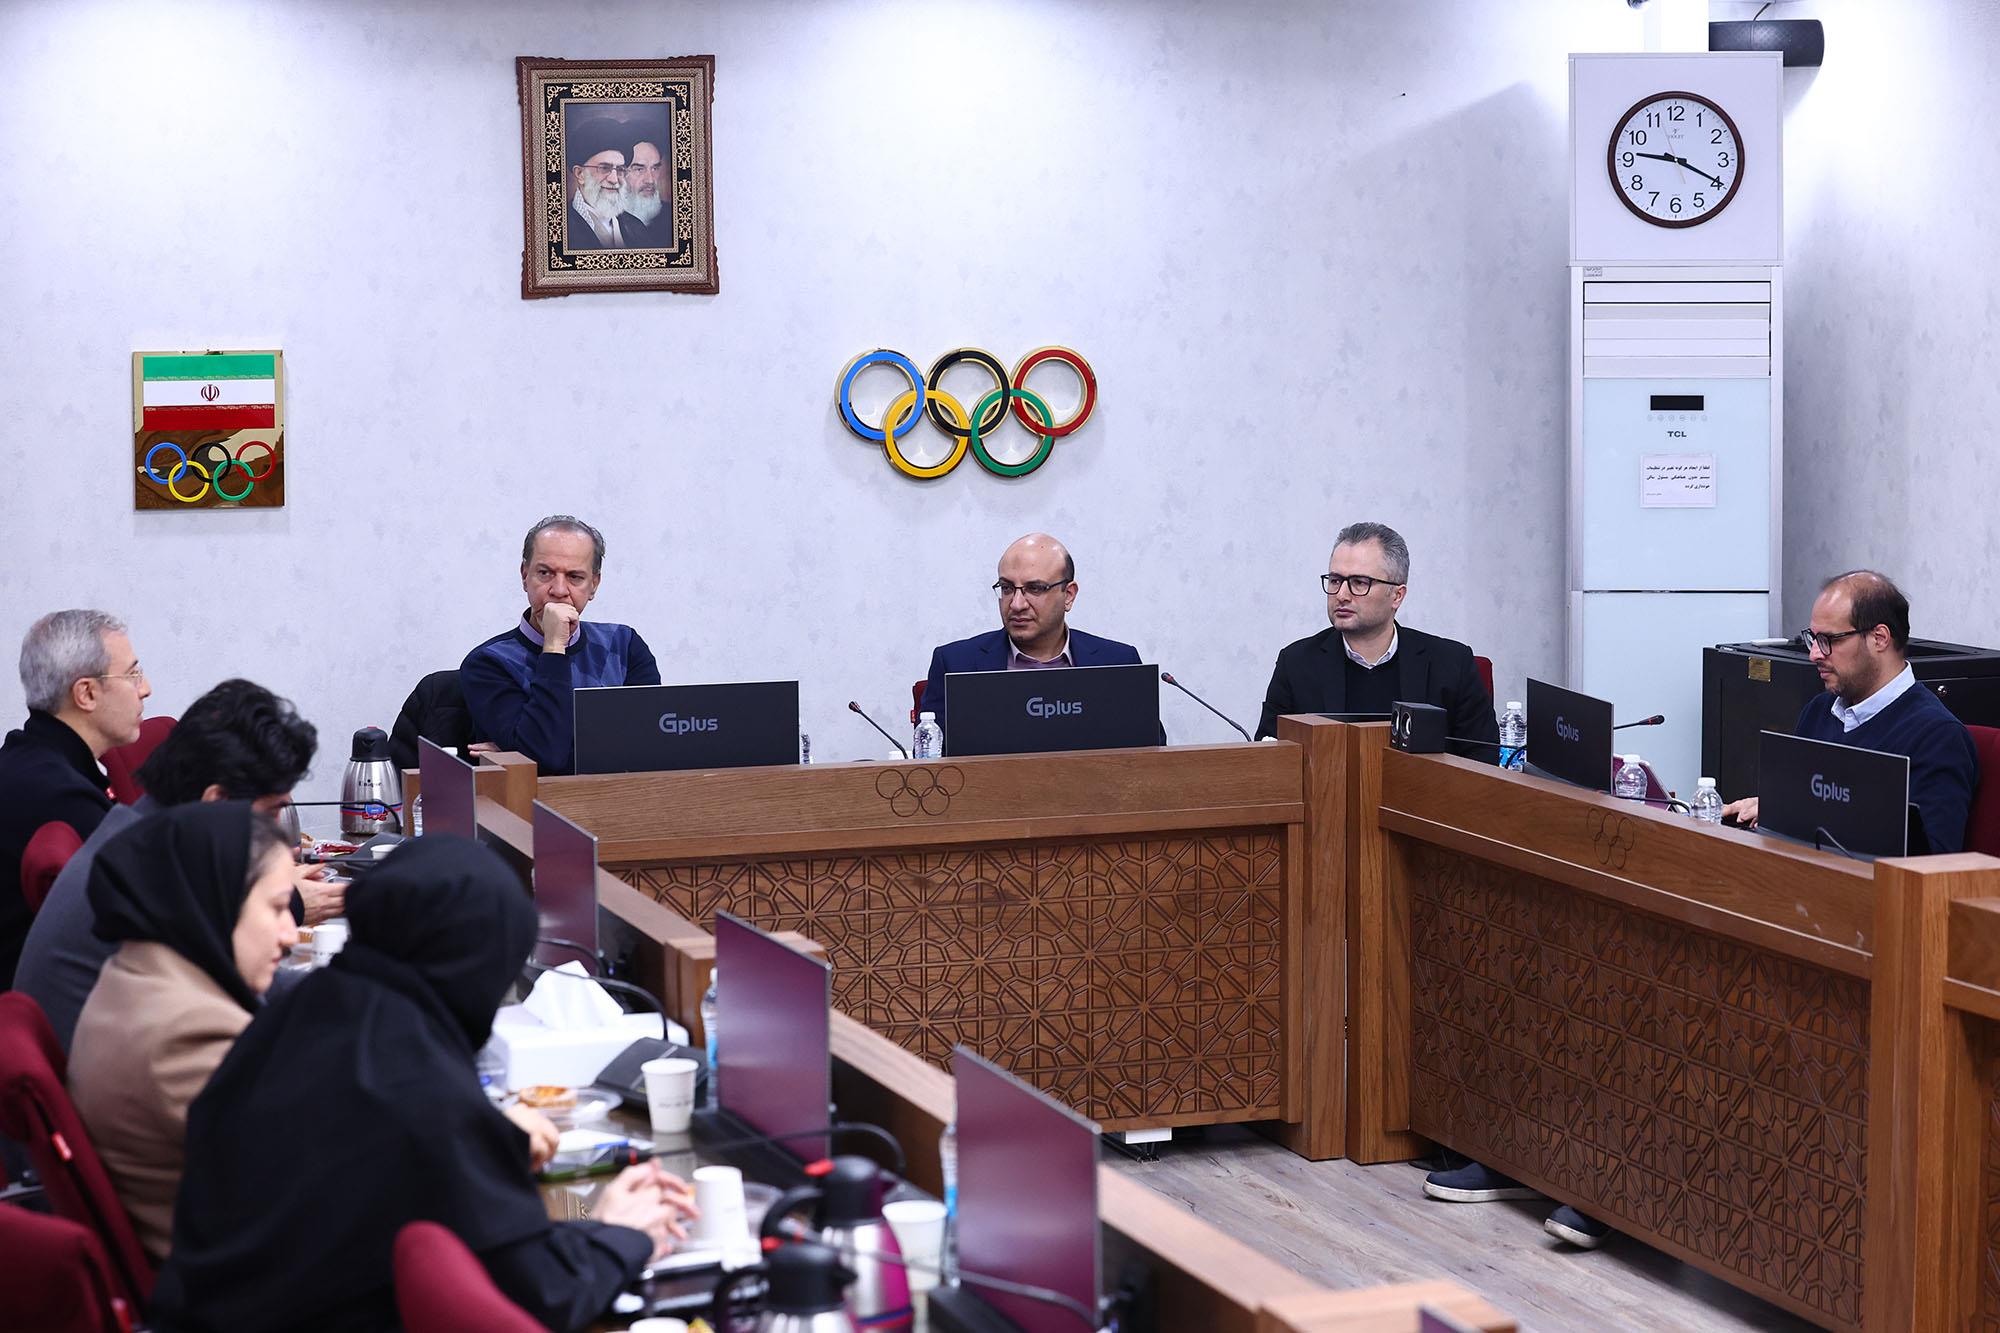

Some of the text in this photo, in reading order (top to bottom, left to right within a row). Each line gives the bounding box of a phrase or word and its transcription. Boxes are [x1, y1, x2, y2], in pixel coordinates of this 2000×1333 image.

[1646, 112, 1660, 128] 11
[1667, 105, 1685, 121] 12
[1696, 112, 1702, 128] 1
[1629, 130, 1647, 146] 10
[1710, 129, 1722, 144] 2
[1622, 152, 1635, 168] 9
[1717, 152, 1729, 168] 3
[1631, 175, 1643, 191] 8
[1710, 175, 1723, 191] 4
[1648, 192, 1660, 207] 7
[1669, 198, 1682, 213] 6
[1693, 193, 1705, 208] 5
[1026, 697, 1083, 719] Gplus
[659, 712, 719, 735] Gplus
[1556, 716, 1580, 742] Gplus
[1810, 773, 1850, 802] Gplus
